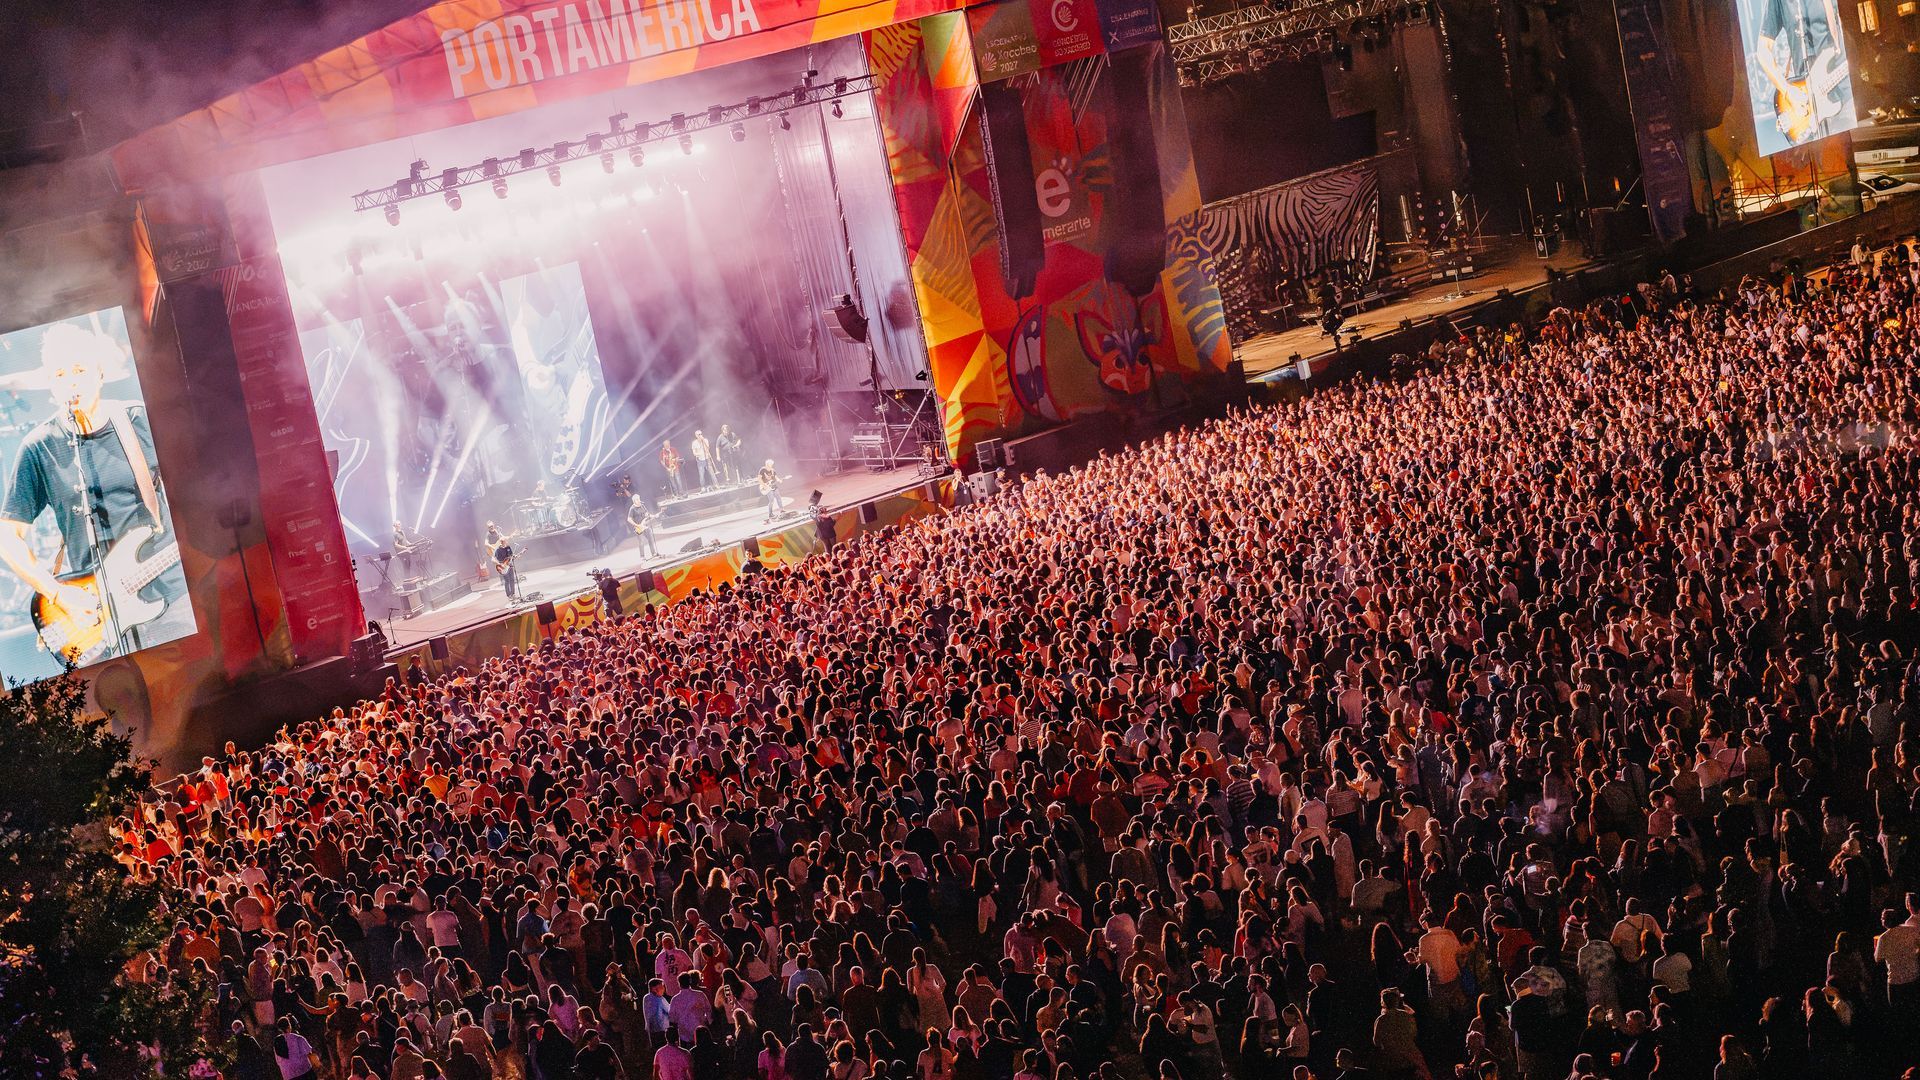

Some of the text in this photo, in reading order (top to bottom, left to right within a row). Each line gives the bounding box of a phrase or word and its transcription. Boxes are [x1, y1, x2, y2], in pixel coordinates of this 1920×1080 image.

[441, 0, 762, 98] PORTAMERICA
[997, 45, 1038, 60] Xacobeo
[1000, 60, 1018, 73] 2027
[455, 791, 468, 805] 20
